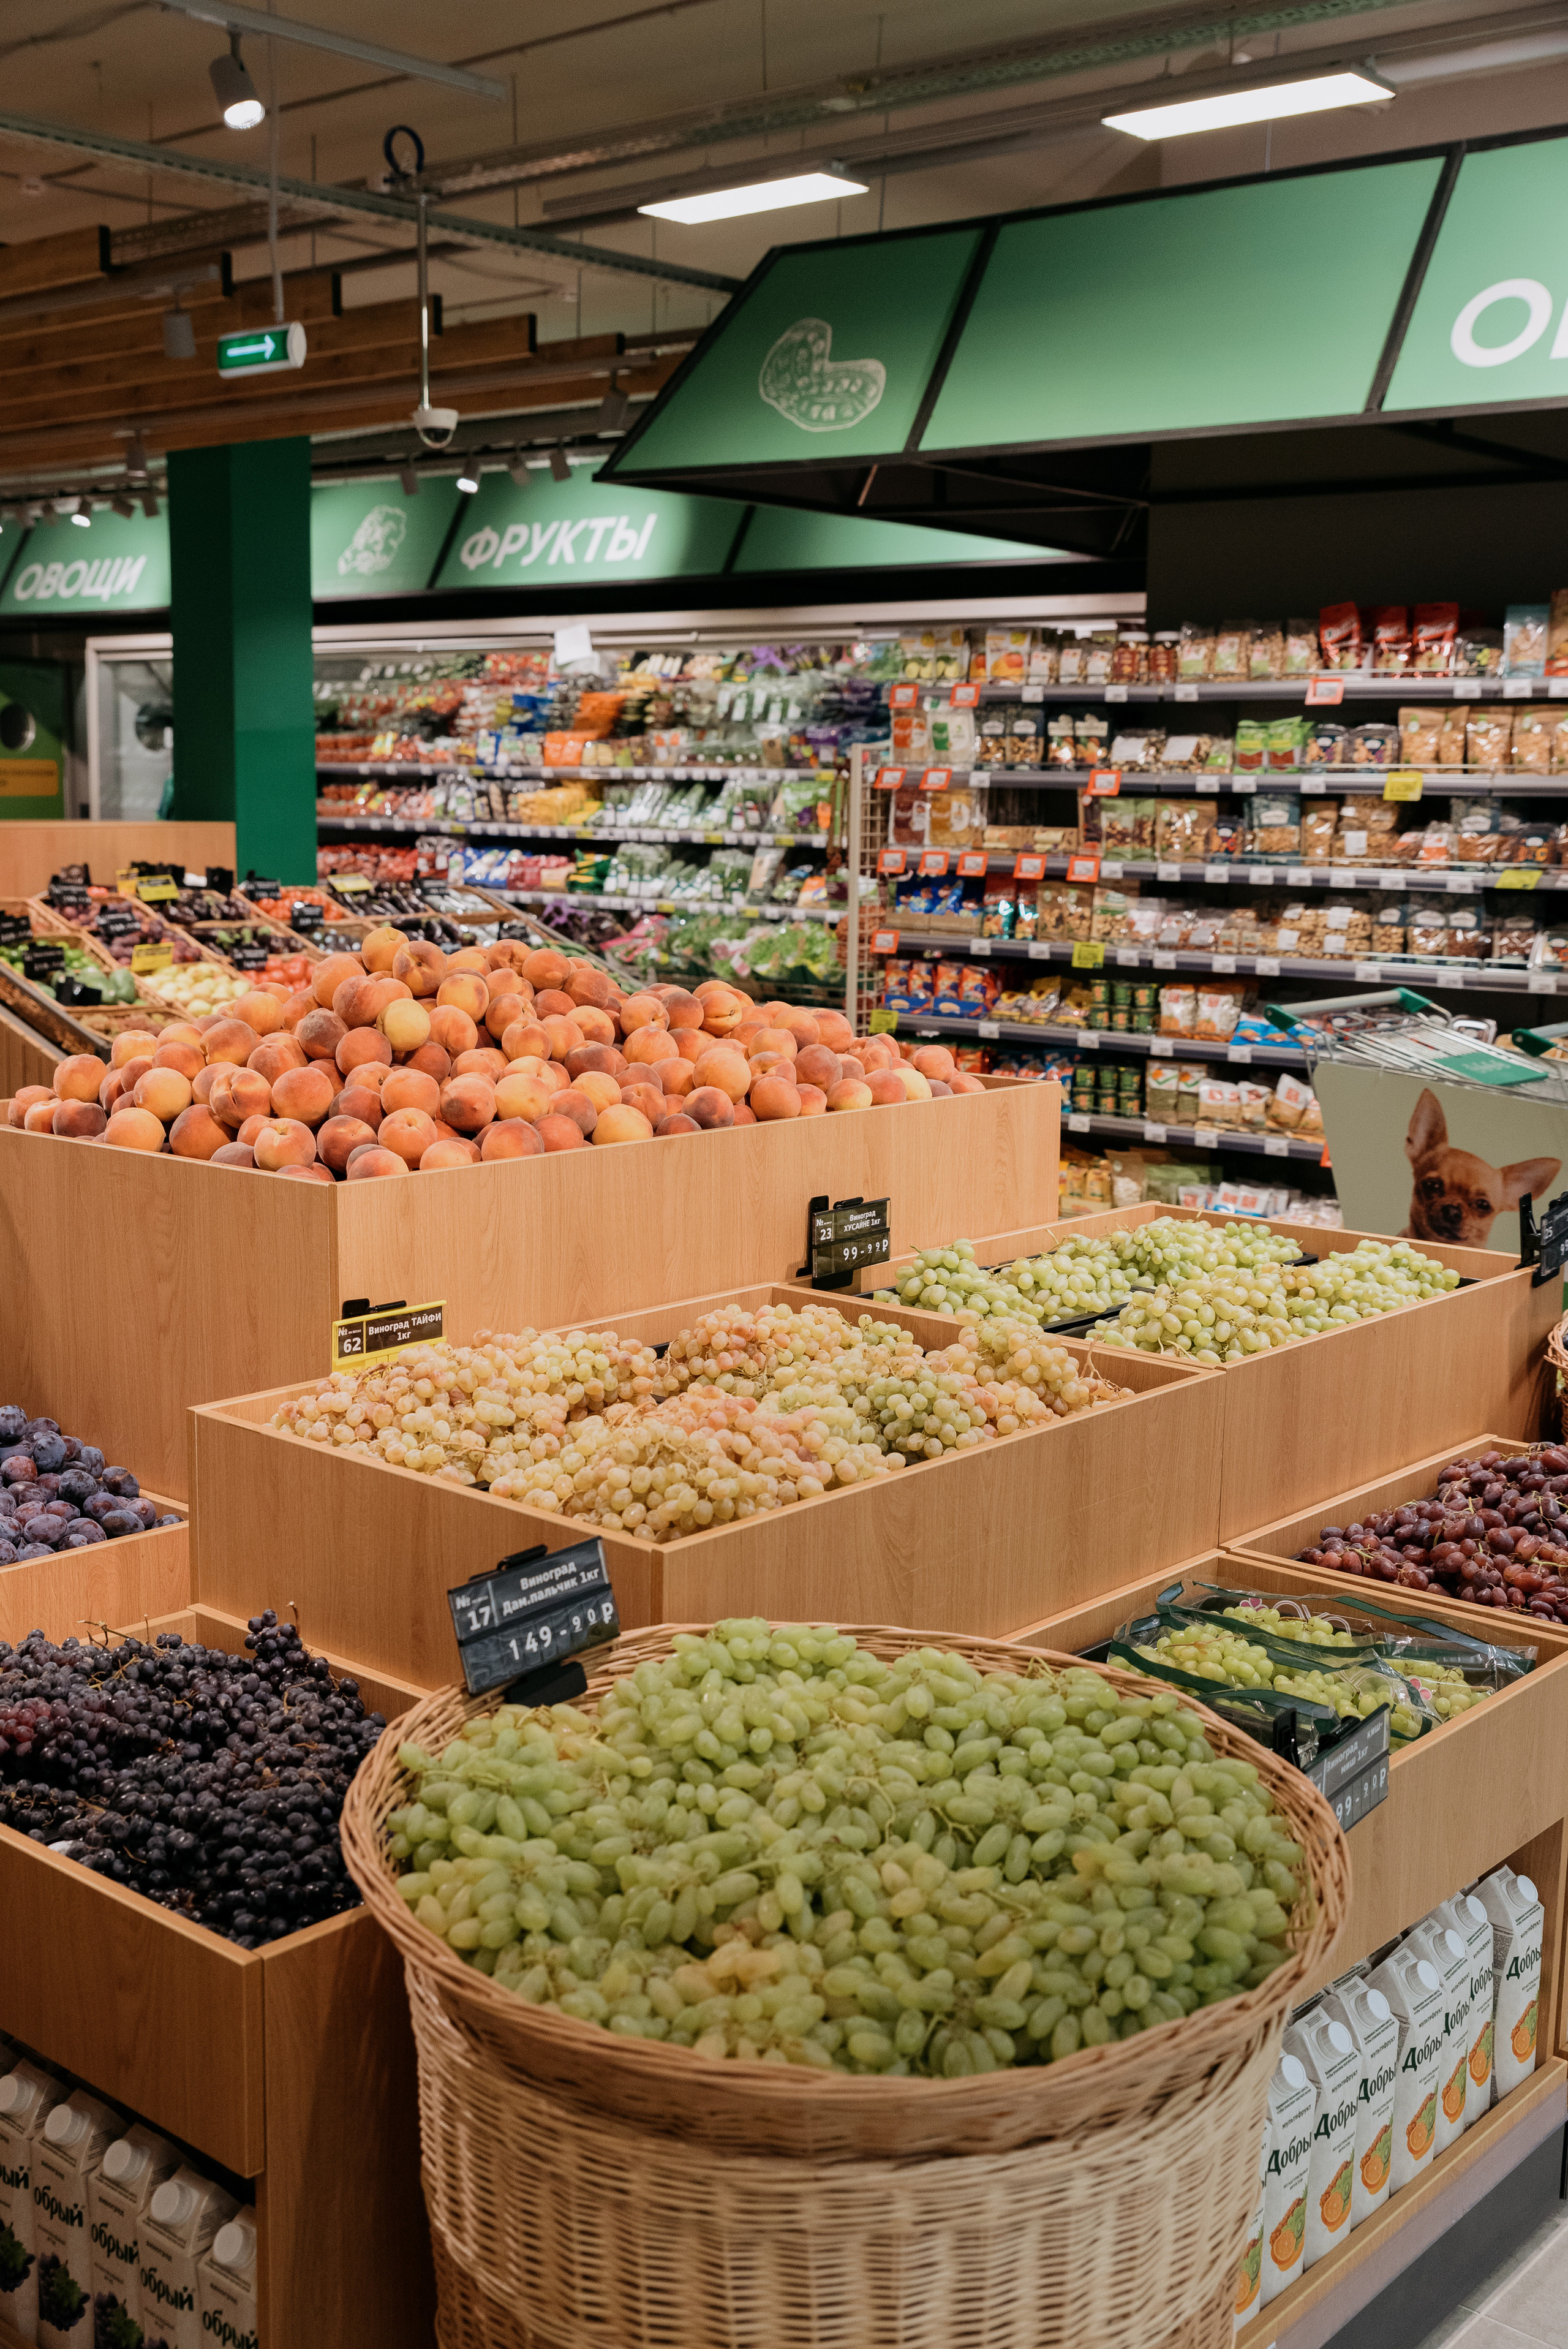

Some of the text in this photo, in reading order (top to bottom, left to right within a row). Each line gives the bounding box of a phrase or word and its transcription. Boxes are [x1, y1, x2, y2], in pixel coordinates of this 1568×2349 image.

[1450, 278, 1568, 368] О
[460, 513, 658, 570] ФРУКТЫ
[14, 554, 148, 602] ОВОЩИ
[850, 1210, 876, 1222] Виноград
[820, 1227, 832, 1241] 23
[844, 1220, 870, 1232] ХУСАЙНЕ
[339, 1326, 347, 1337] №
[368, 1312, 442, 1335] Виноград ТАЙФИ
[397, 1331, 411, 1341] 1кг
[344, 1337, 361, 1353] 62
[520, 1562, 577, 1591] Виноград
[580, 1568, 599, 1584] 1кг
[467, 1605, 491, 1631] 17
[1357, 1746, 1369, 1761] 1кг
